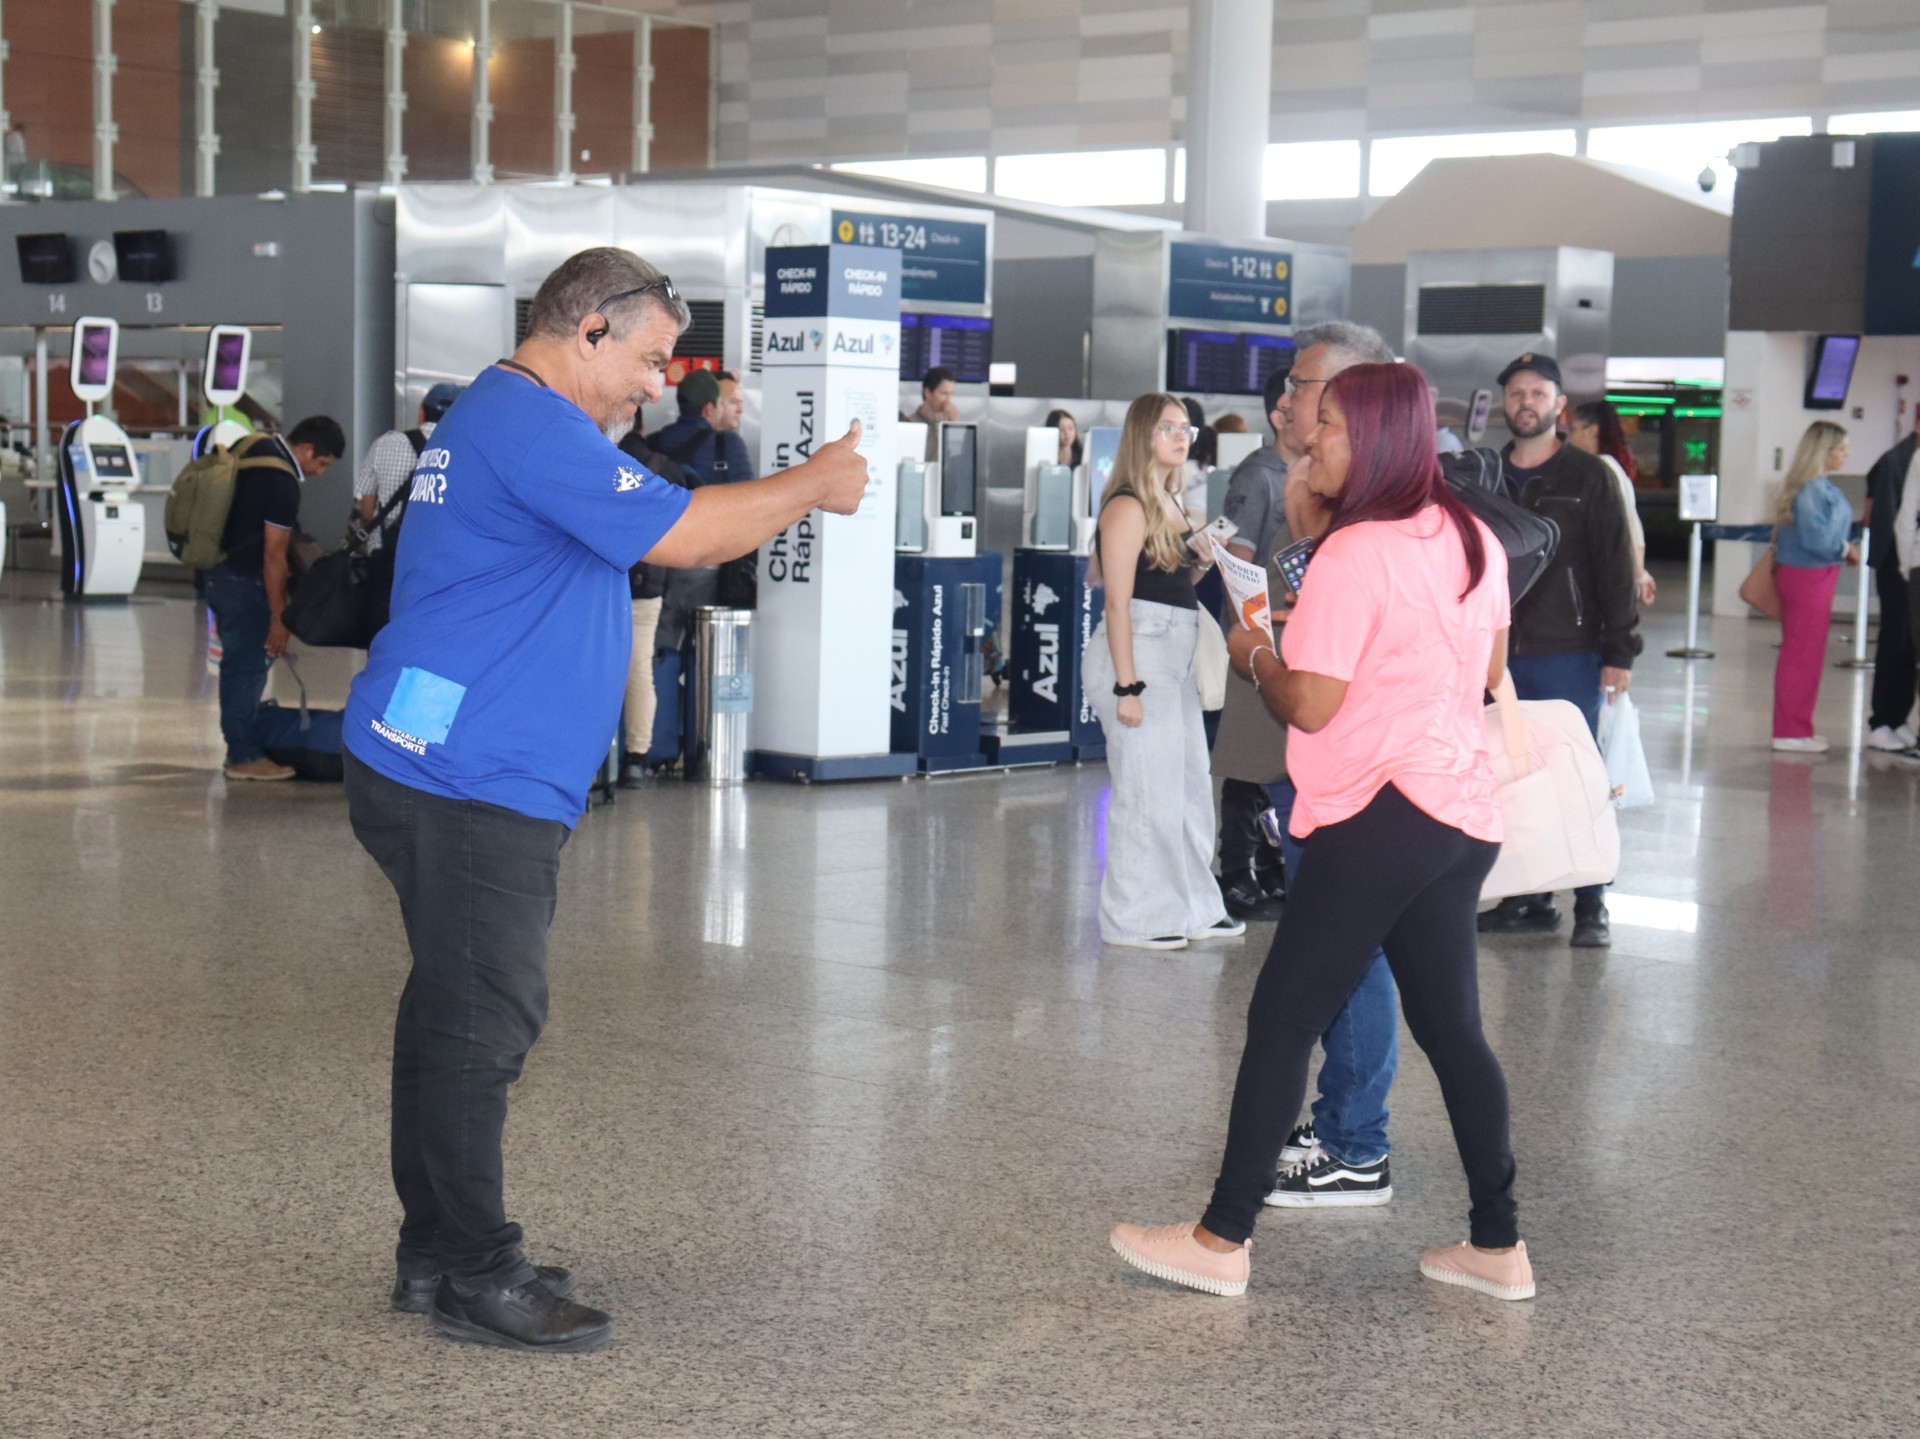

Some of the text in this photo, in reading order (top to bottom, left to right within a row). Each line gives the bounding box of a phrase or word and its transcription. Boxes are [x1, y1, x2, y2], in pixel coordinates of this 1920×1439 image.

[880, 223, 927, 250] 13-24
[776, 267, 817, 280] CHECK-IN
[843, 268, 887, 282] CHECK-IN
[1231, 255, 1257, 279] 1-12
[49, 293, 66, 313] 14
[145, 292, 163, 313] 13
[767, 331, 804, 352] Azul
[833, 331, 874, 354] Azul
[795, 391, 814, 458] Azul
[891, 629, 908, 713] Azul
[929, 584, 943, 735] Check-in Rápido Azul
[1032, 623, 1060, 704] Azul
[942, 665, 950, 710] Check-in
[371, 719, 426, 756] TRANSPORTE
[417, 738, 428, 747] DE
